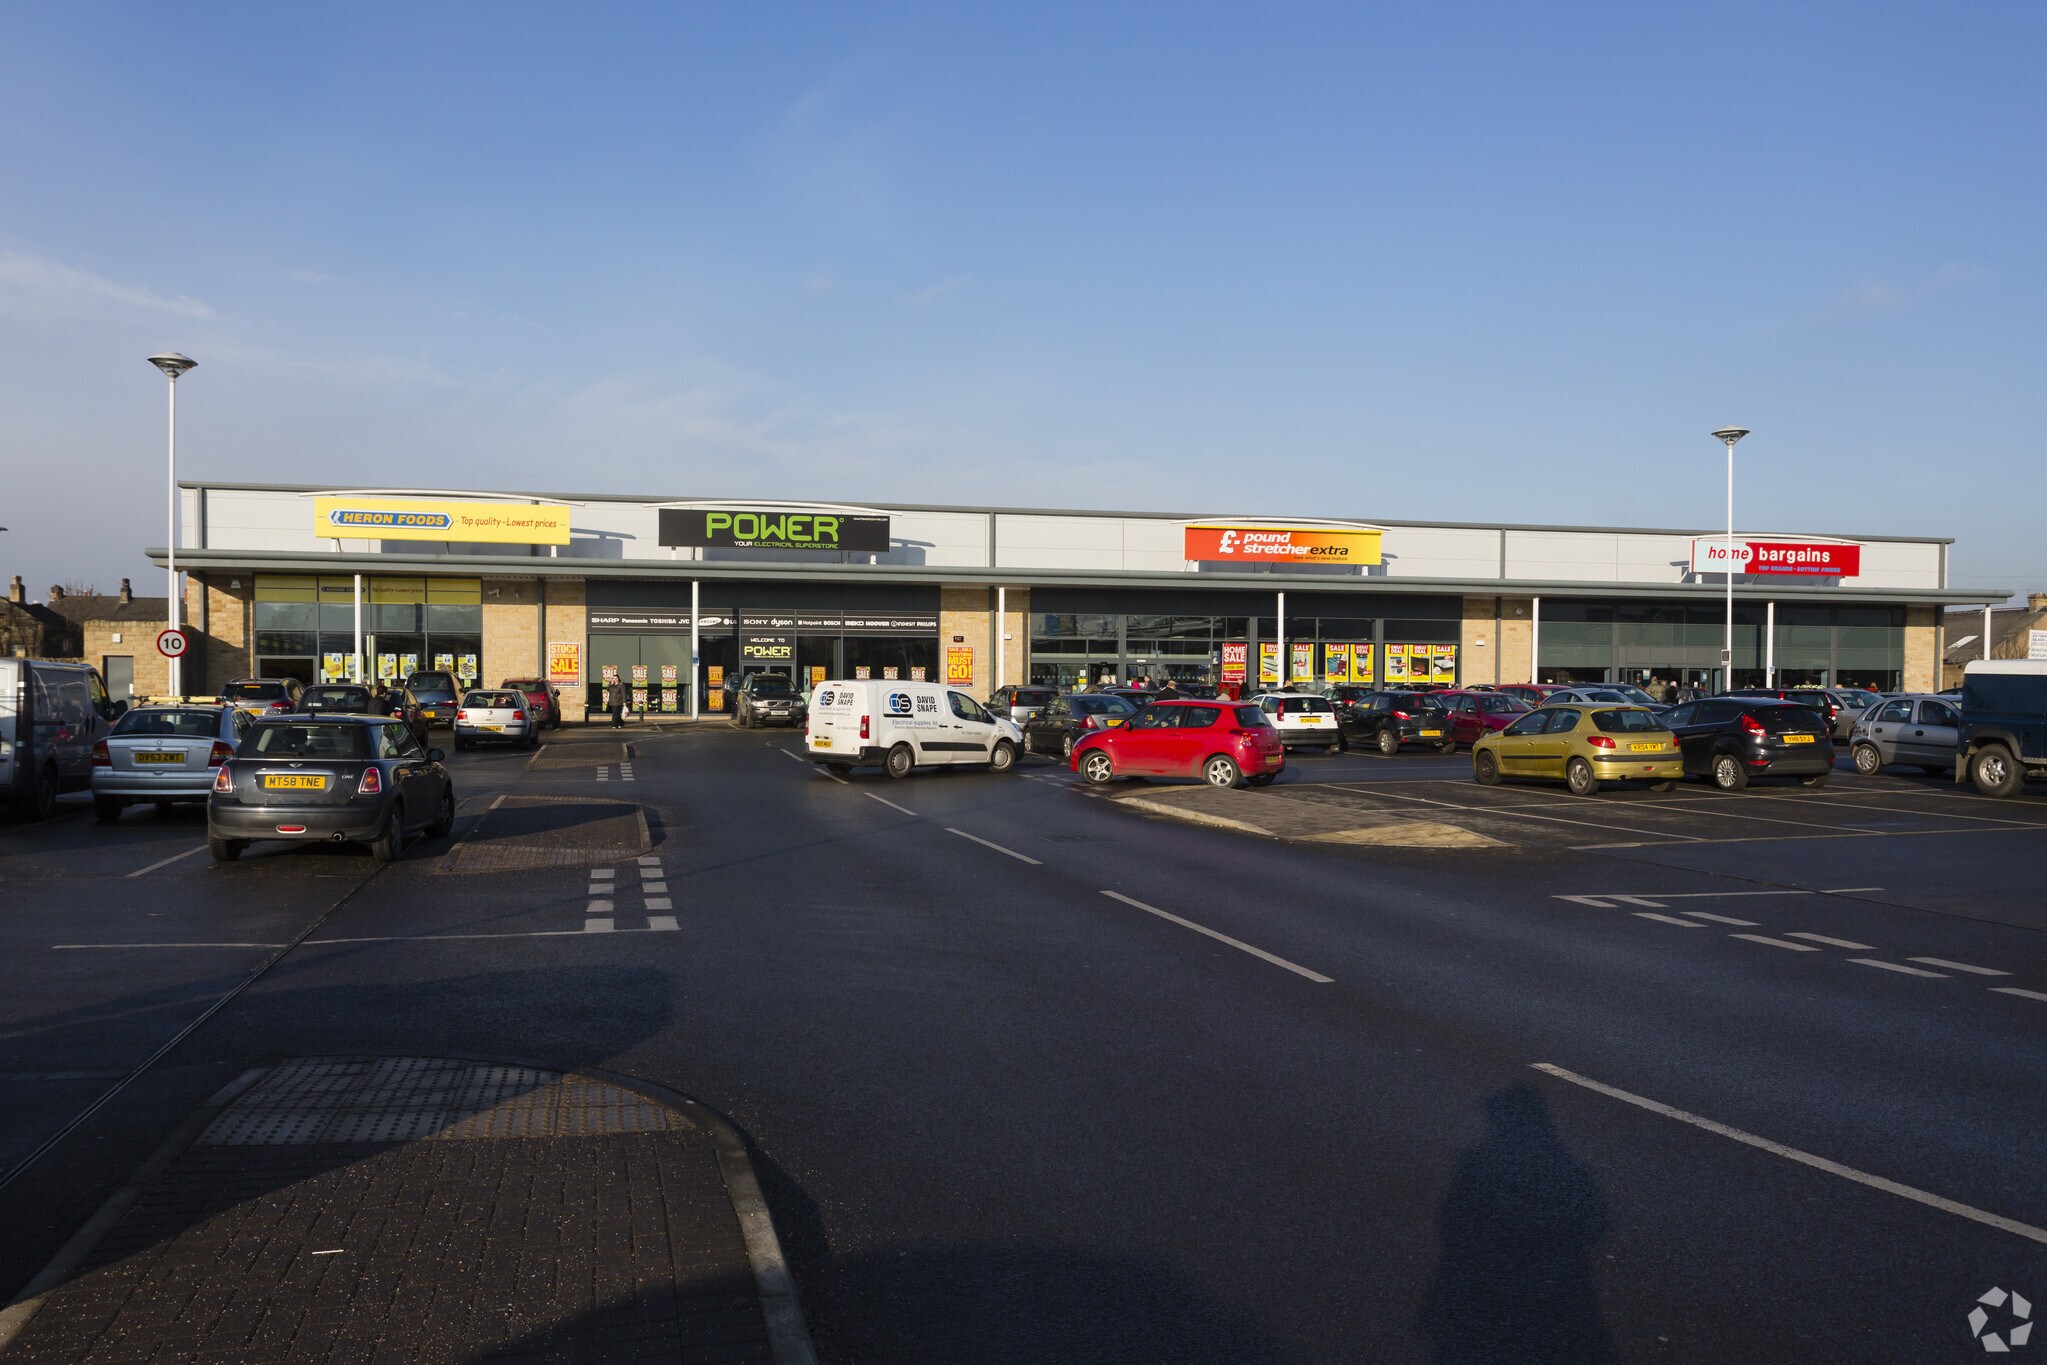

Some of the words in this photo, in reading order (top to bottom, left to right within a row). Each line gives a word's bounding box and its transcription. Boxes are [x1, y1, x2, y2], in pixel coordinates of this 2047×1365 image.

[343, 512, 394, 524] HERON
[398, 514, 444, 526] FOODS
[460, 516, 473, 526] Top
[475, 516, 501, 528] quality
[507, 518, 534, 527] Lowest
[535, 520, 557, 529] prices
[706, 512, 839, 542] POWER
[1244, 532, 1292, 545] pound
[1708, 546, 1749, 560] home
[1759, 547, 1830, 563] bargains
[771, 618, 793, 627] dyson
[164, 638, 182, 649] 10
[551, 644, 578, 653] STOCK
[744, 646, 790, 656] POWER
[948, 657, 972, 665] MUST
[1224, 654, 1245, 662] SALE
[551, 658, 578, 672] SALE
[603, 669, 617, 678] SALE
[632, 669, 647, 678] SALE
[662, 669, 677, 678] SALE
[856, 671, 870, 679] SALE
[884, 671, 898, 679] SALE
[912, 671, 925, 679] SALE
[948, 665, 972, 678] GO!
[633, 692, 647, 702] SALE
[662, 692, 677, 702] SALE
[270, 777, 296, 786] MT58
[301, 778, 320, 786] TNE
